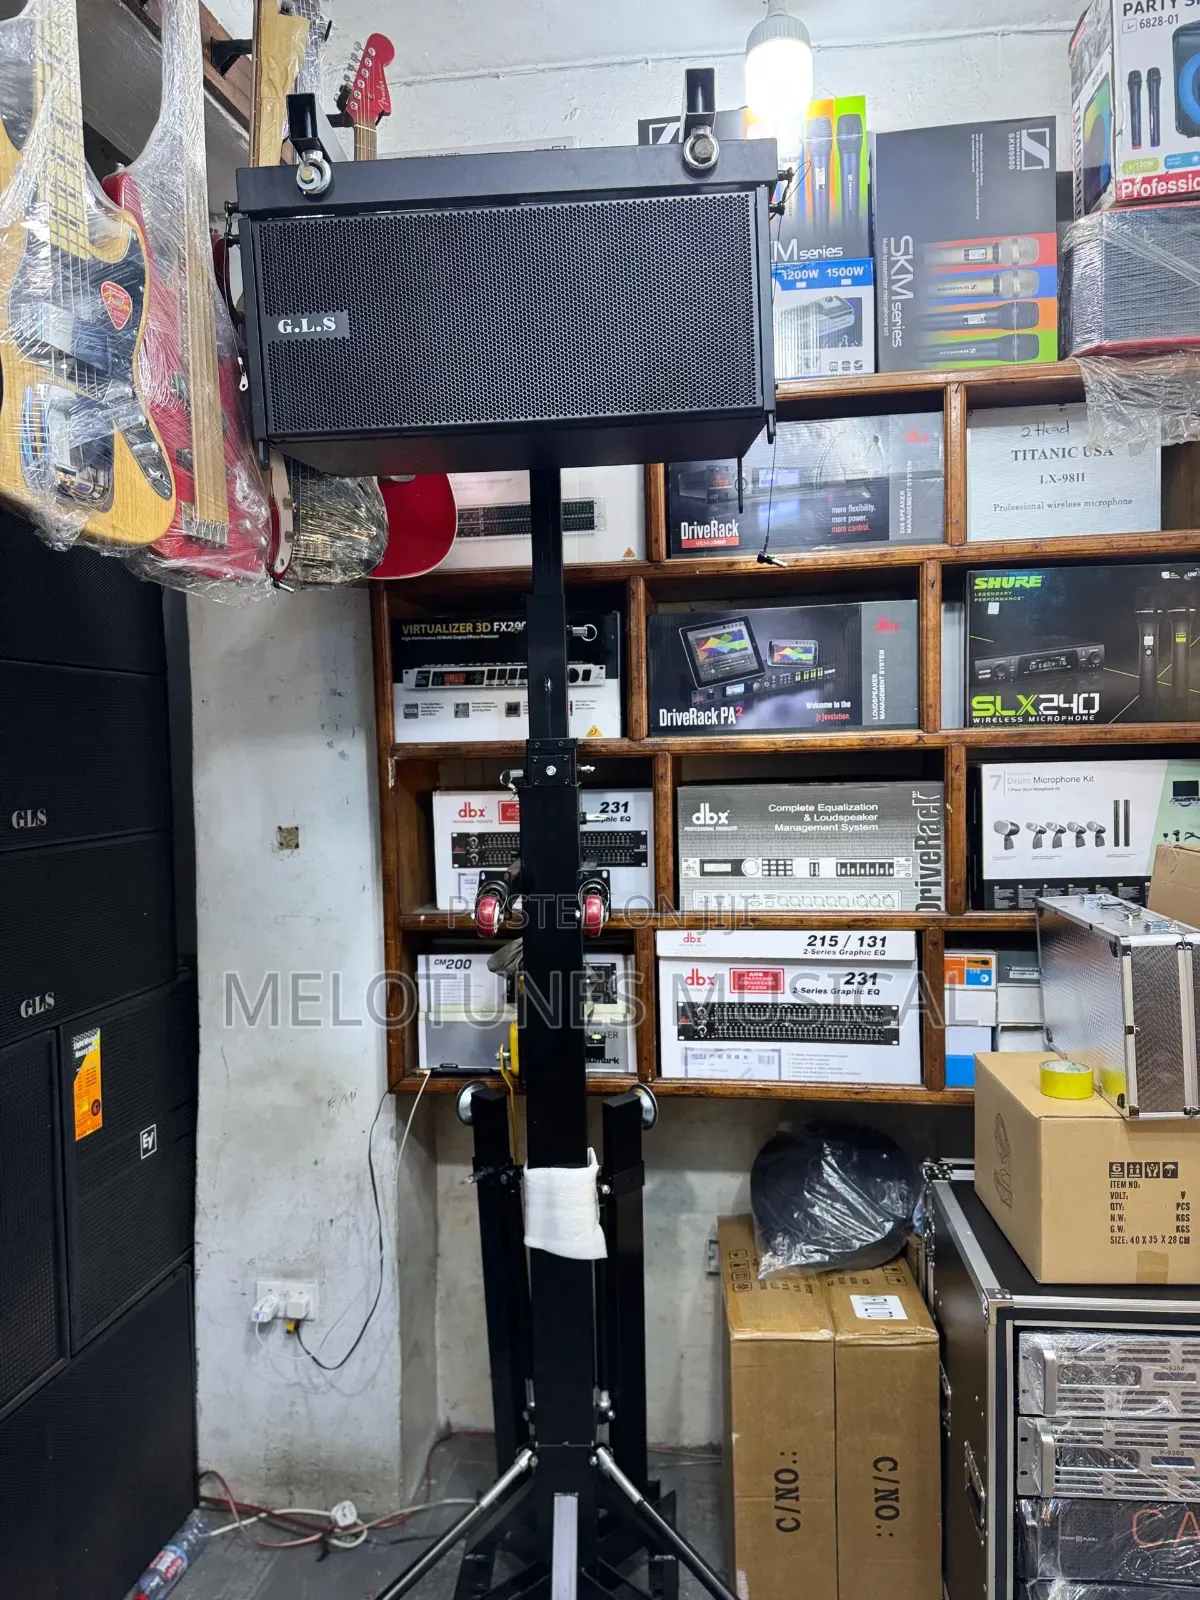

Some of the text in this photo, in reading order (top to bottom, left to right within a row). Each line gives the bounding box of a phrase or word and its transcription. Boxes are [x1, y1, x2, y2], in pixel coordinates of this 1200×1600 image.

[1139, 14, 1179, 29] 6828-01
[800, 245, 843, 260] series
[782, 266, 864, 280] 1200W 1500W
[890, 235, 914, 348] SKM series
[278, 316, 336, 334] G.L.S
[1021, 419, 1070, 438] 2 Head
[1011, 445, 1114, 462] TITANIC USA
[848, 503, 876, 513] flexibility.
[993, 497, 1133, 512] Professional wireless microphone
[848, 515, 868, 523] power.
[681, 519, 740, 539] DriveRack
[974, 576, 1043, 590] SHURE
[402, 622, 474, 635] VIRTUALIZER
[476, 622, 491, 632] 3D
[806, 700, 851, 709] Welcome to the
[972, 692, 1100, 717] SLX240
[659, 706, 720, 727] DriveRack
[1029, 714, 1095, 722] MICROPHONE
[1033, 776, 1081, 785] Microphone
[1083, 775, 1094, 783] Kit
[458, 801, 486, 818] dbx
[599, 801, 629, 814] 231
[692, 803, 729, 825] dbx
[768, 802, 878, 813] Complete Equalization
[11, 807, 47, 829] GLS
[803, 812, 879, 822] & Loudspeaker
[774, 823, 878, 833] Management System
[683, 932, 702, 943] dbx
[807, 934, 887, 948] 215 / 131
[803, 948, 835, 956] 2-Series
[838, 949, 871, 957] Graphic
[434, 958, 472, 970] CM200
[684, 968, 715, 986] dbx
[843, 972, 878, 986] 231
[830, 987, 864, 995] Graphic
[20, 991, 55, 1018] GLS
[1110, 1180, 1140, 1189] ITEM NO:
[1110, 1191, 1128, 1200] VOLT:
[1110, 1202, 1190, 1211] QTY: PCS
[1110, 1213, 1190, 1222] N.W: KGS
[1110, 1225, 1190, 1233] G.W: KGS
[1110, 1234, 1190, 1245] SIZE: 40 X 35 X 28 CM
[773, 1451, 801, 1533] C/NO.:
[1132, 1508, 1200, 1550] CA
